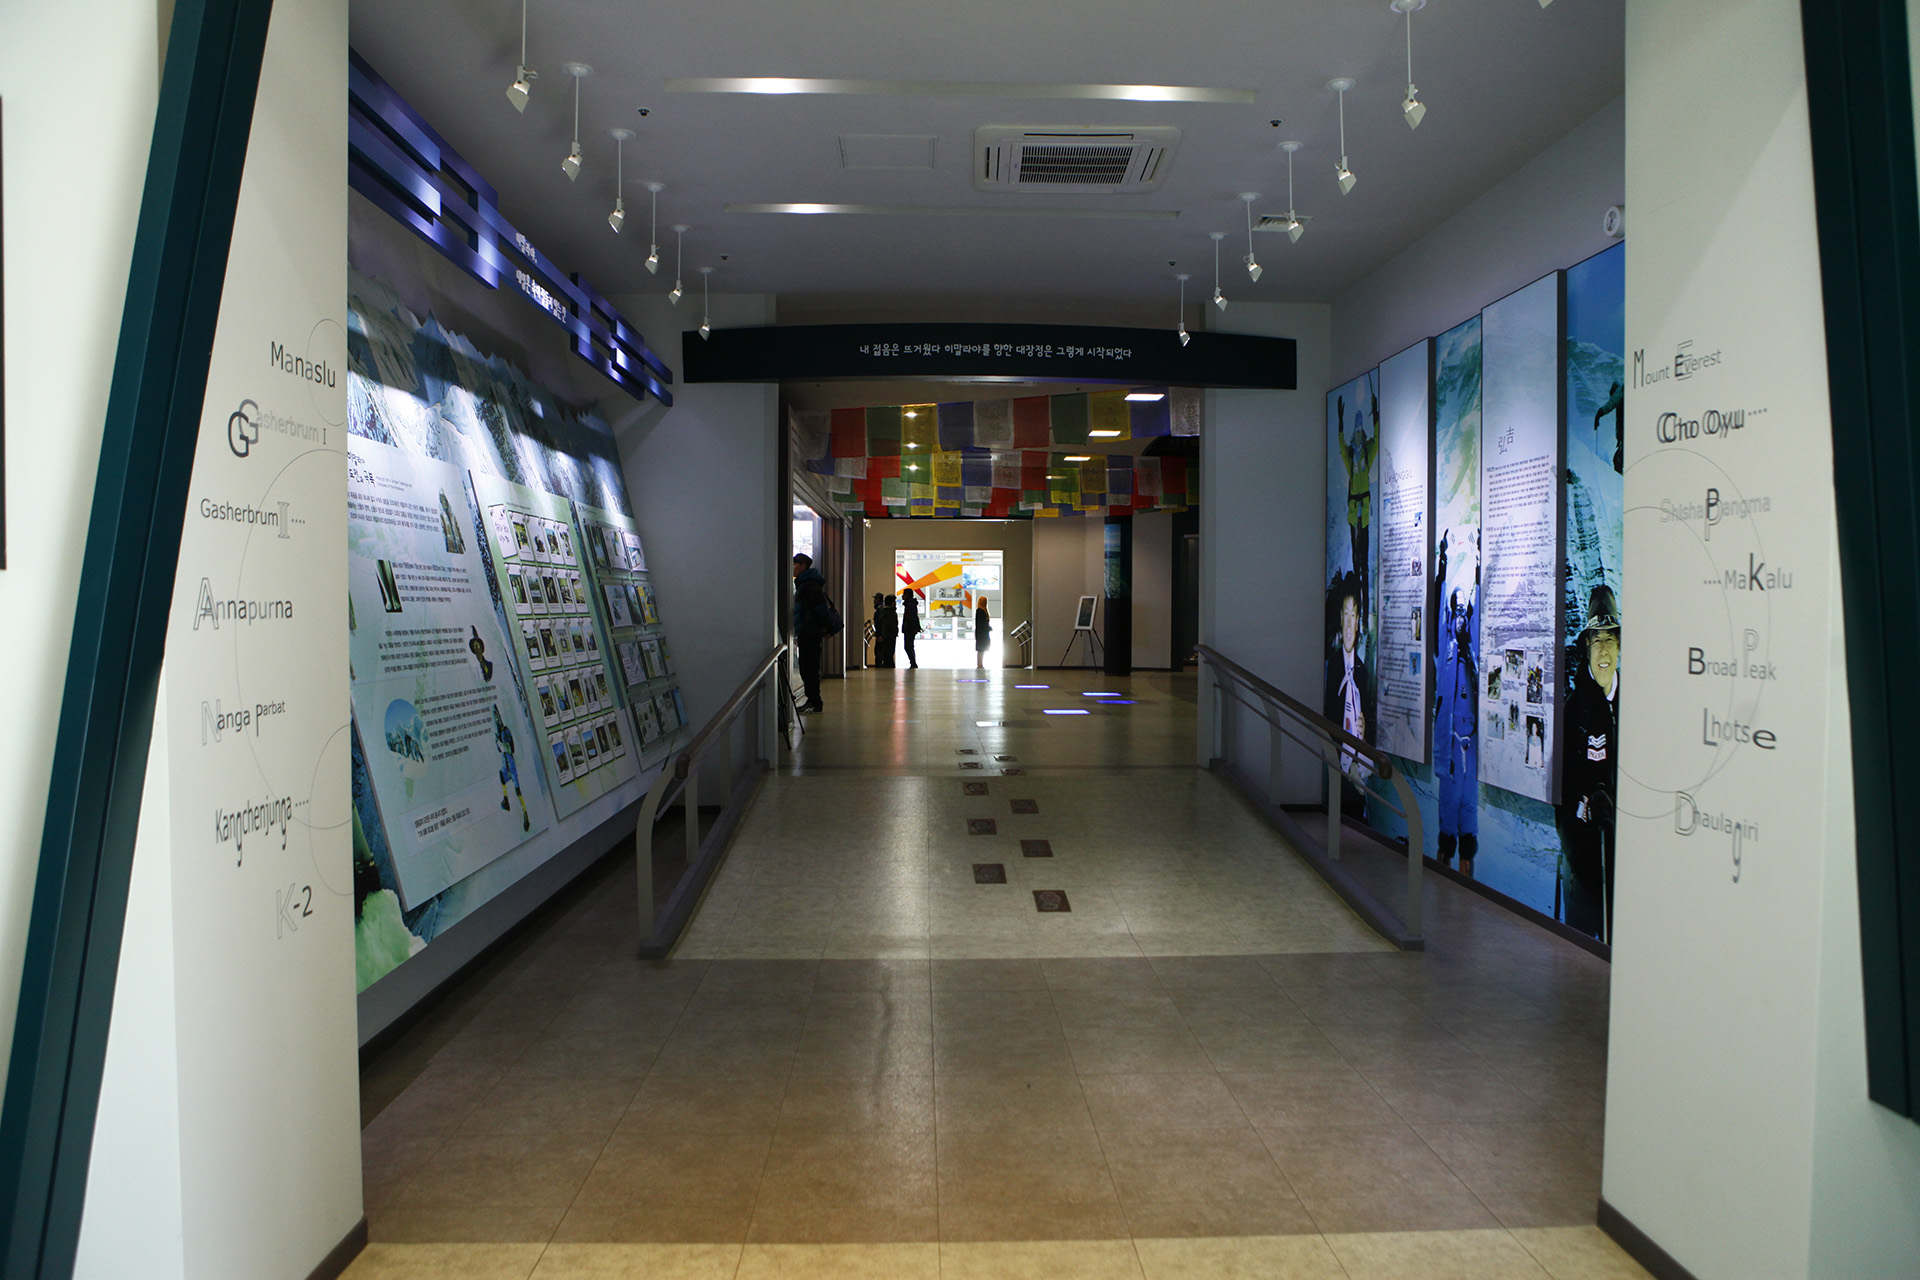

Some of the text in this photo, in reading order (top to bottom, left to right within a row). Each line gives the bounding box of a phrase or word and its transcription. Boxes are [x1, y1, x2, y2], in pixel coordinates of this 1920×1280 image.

[270, 341, 336, 389] Manaslu
[859, 343, 1133, 360] 내 젊음은 뜨거웠다 히말라야를 향한 대장정은 그렇게 시작되었다
[1633, 339, 1722, 389] Mount Everest
[321, 427, 328, 445] I
[1656, 411, 1700, 444] Cho
[193, 577, 293, 631] Annapurna
[1688, 628, 1777, 681] Broad Peak
[201, 698, 287, 746] Nanga Parbat
[1703, 706, 1777, 750] Lhotse
[1675, 790, 1759, 884] Dhaulagiri
[276, 882, 313, 939] K-2
